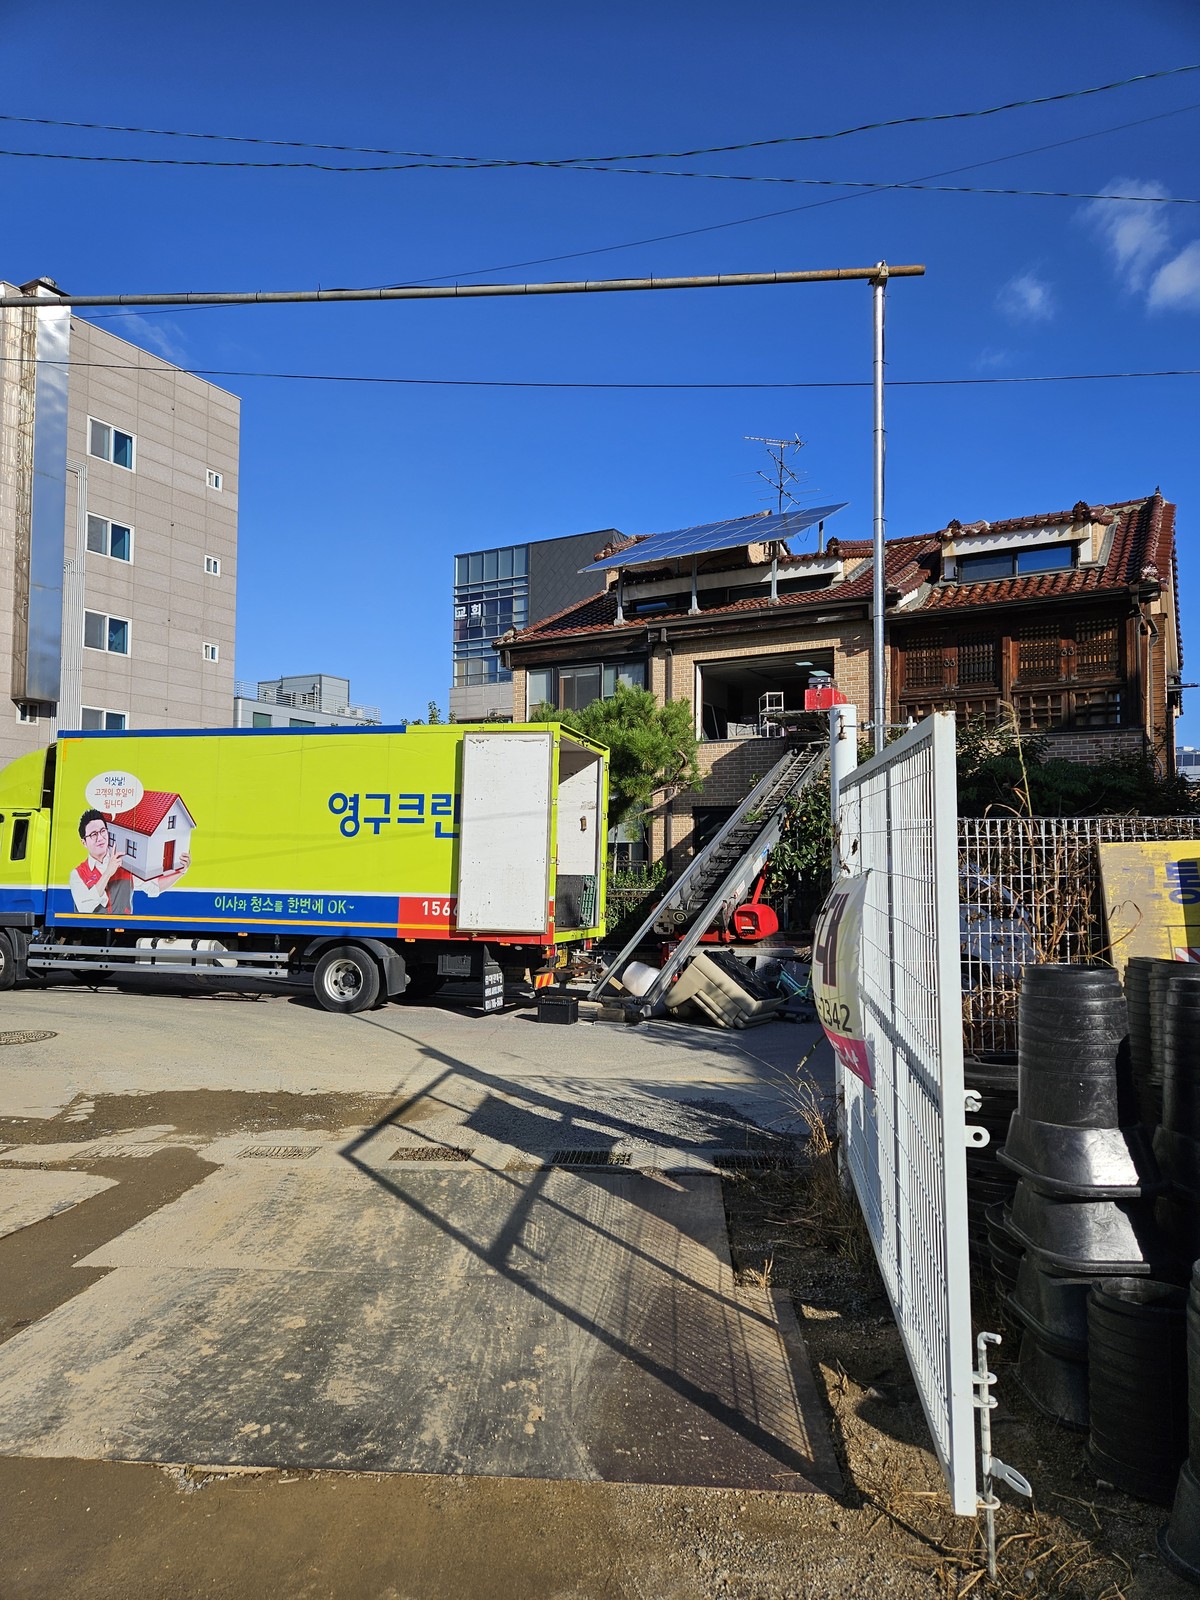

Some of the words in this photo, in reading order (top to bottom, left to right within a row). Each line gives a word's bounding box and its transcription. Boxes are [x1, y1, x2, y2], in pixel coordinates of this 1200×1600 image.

[455, 603, 481, 618] 교회
[104, 776, 126, 786] 이삿날!
[94, 788, 114, 798] 고객의
[115, 788, 135, 798] 휴일이
[104, 800, 124, 809] 됩니다
[328, 792, 461, 838] 영구크린
[214, 895, 247, 911] 이사와
[250, 896, 284, 913] 청소를
[287, 897, 324, 915] 한번에
